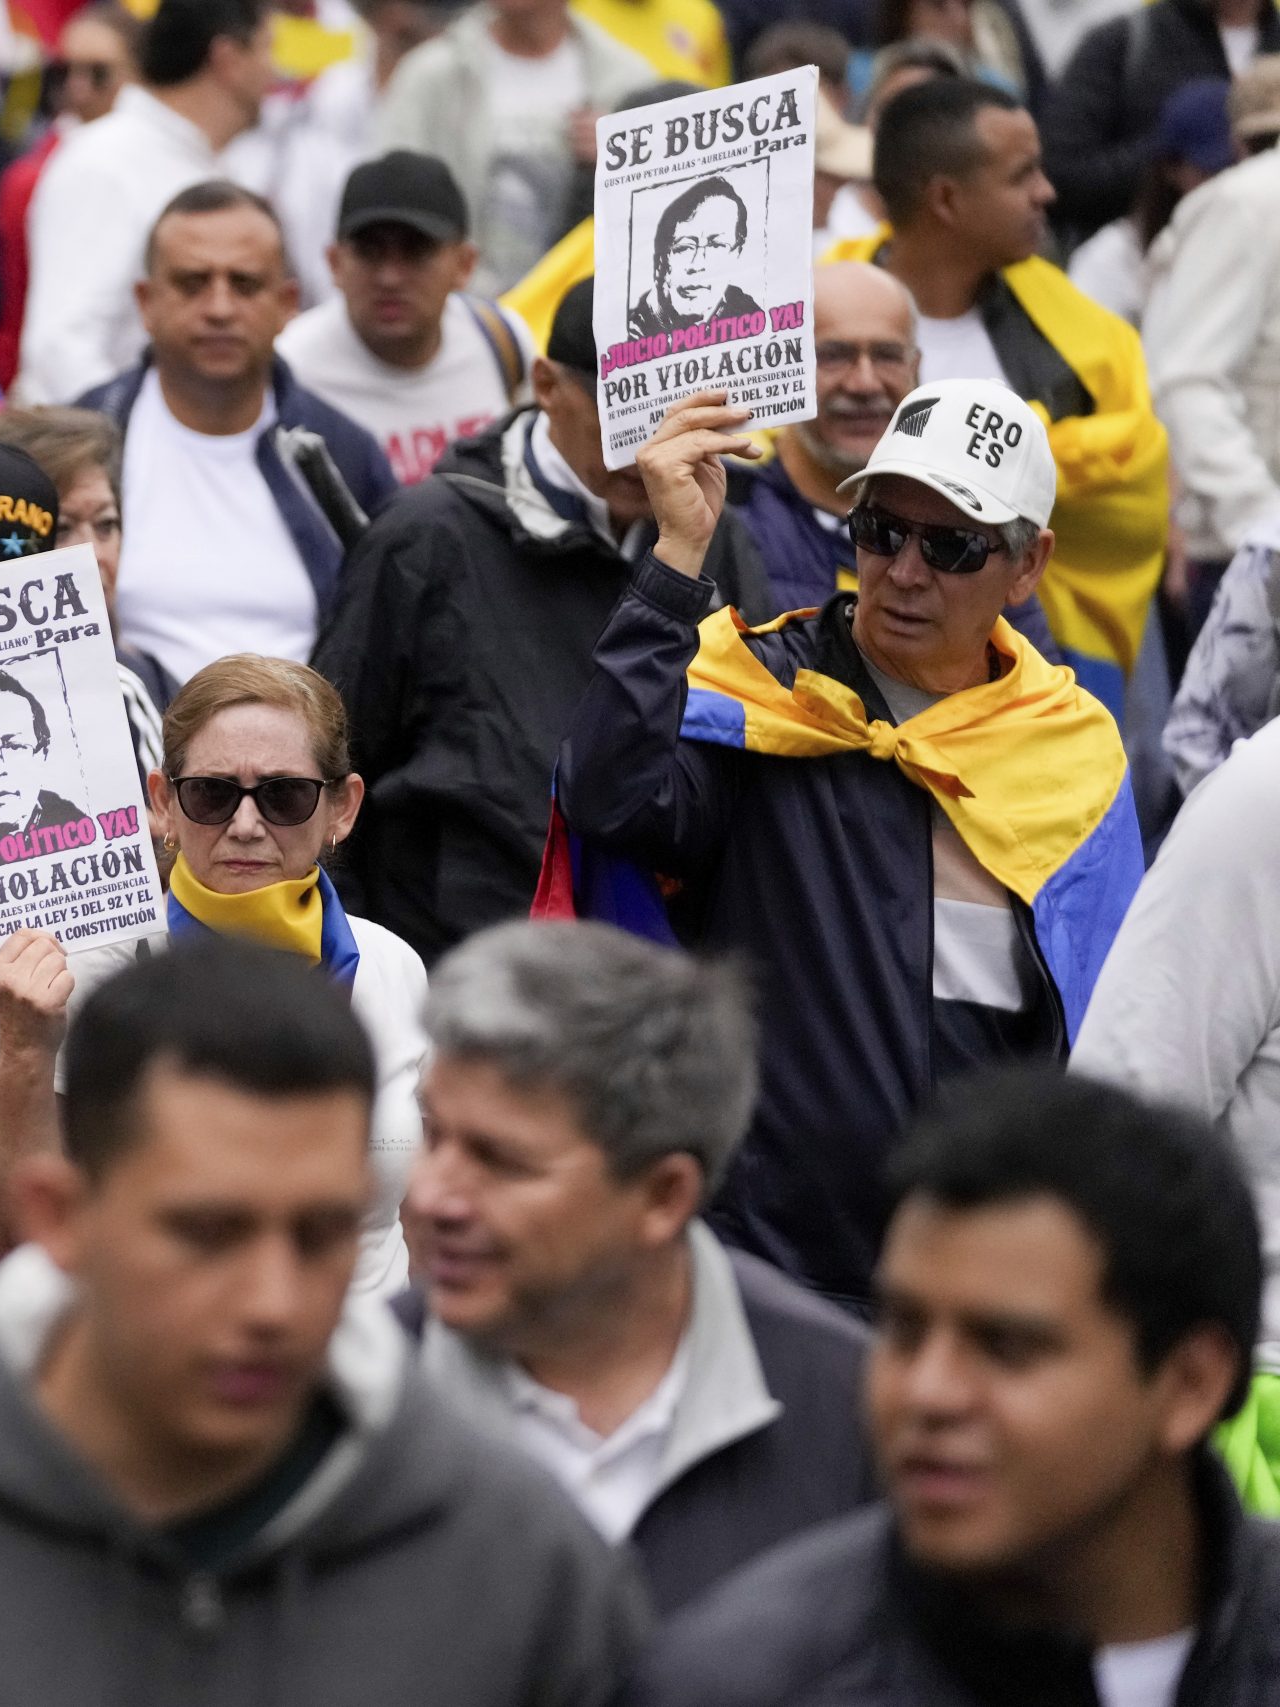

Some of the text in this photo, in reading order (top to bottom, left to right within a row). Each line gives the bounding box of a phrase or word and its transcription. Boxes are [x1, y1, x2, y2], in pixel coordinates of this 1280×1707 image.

[605, 88, 801, 171] SE BUSCA
[754, 133, 807, 156] Para
[605, 173, 641, 188] GUSTAVO
[644, 166, 669, 179] PETRO
[672, 159, 695, 172] ALIAS
[671, 310, 766, 353] POLÍTICO
[770, 301, 804, 332] YA!
[604, 335, 803, 408] POR VIOLACIÓN
[617, 404, 636, 418] TOPES
[747, 367, 805, 385] PRESIDENCIAL
[732, 379, 805, 404] 5 DEL 92 Y EL
[610, 433, 647, 451] CONGRESO
[965, 403, 1022, 448] ERO
[966, 432, 1003, 467] ES
[35, 622, 101, 647] Para
[97, 805, 139, 840] YA!
[24, 902, 36, 912] EN
[39, 891, 83, 909] CAMPAÑA
[86, 875, 150, 898] PRESIDENCIAL
[26, 915, 43, 928] LA
[45, 909, 67, 925] LEY
[71, 906, 78, 919] 5
[81, 900, 105, 916] DEL
[108, 896, 123, 910] 92
[125, 893, 133, 906] Y
[137, 889, 153, 903] EL
[66, 907, 156, 941] CONSTITUCIÓN
